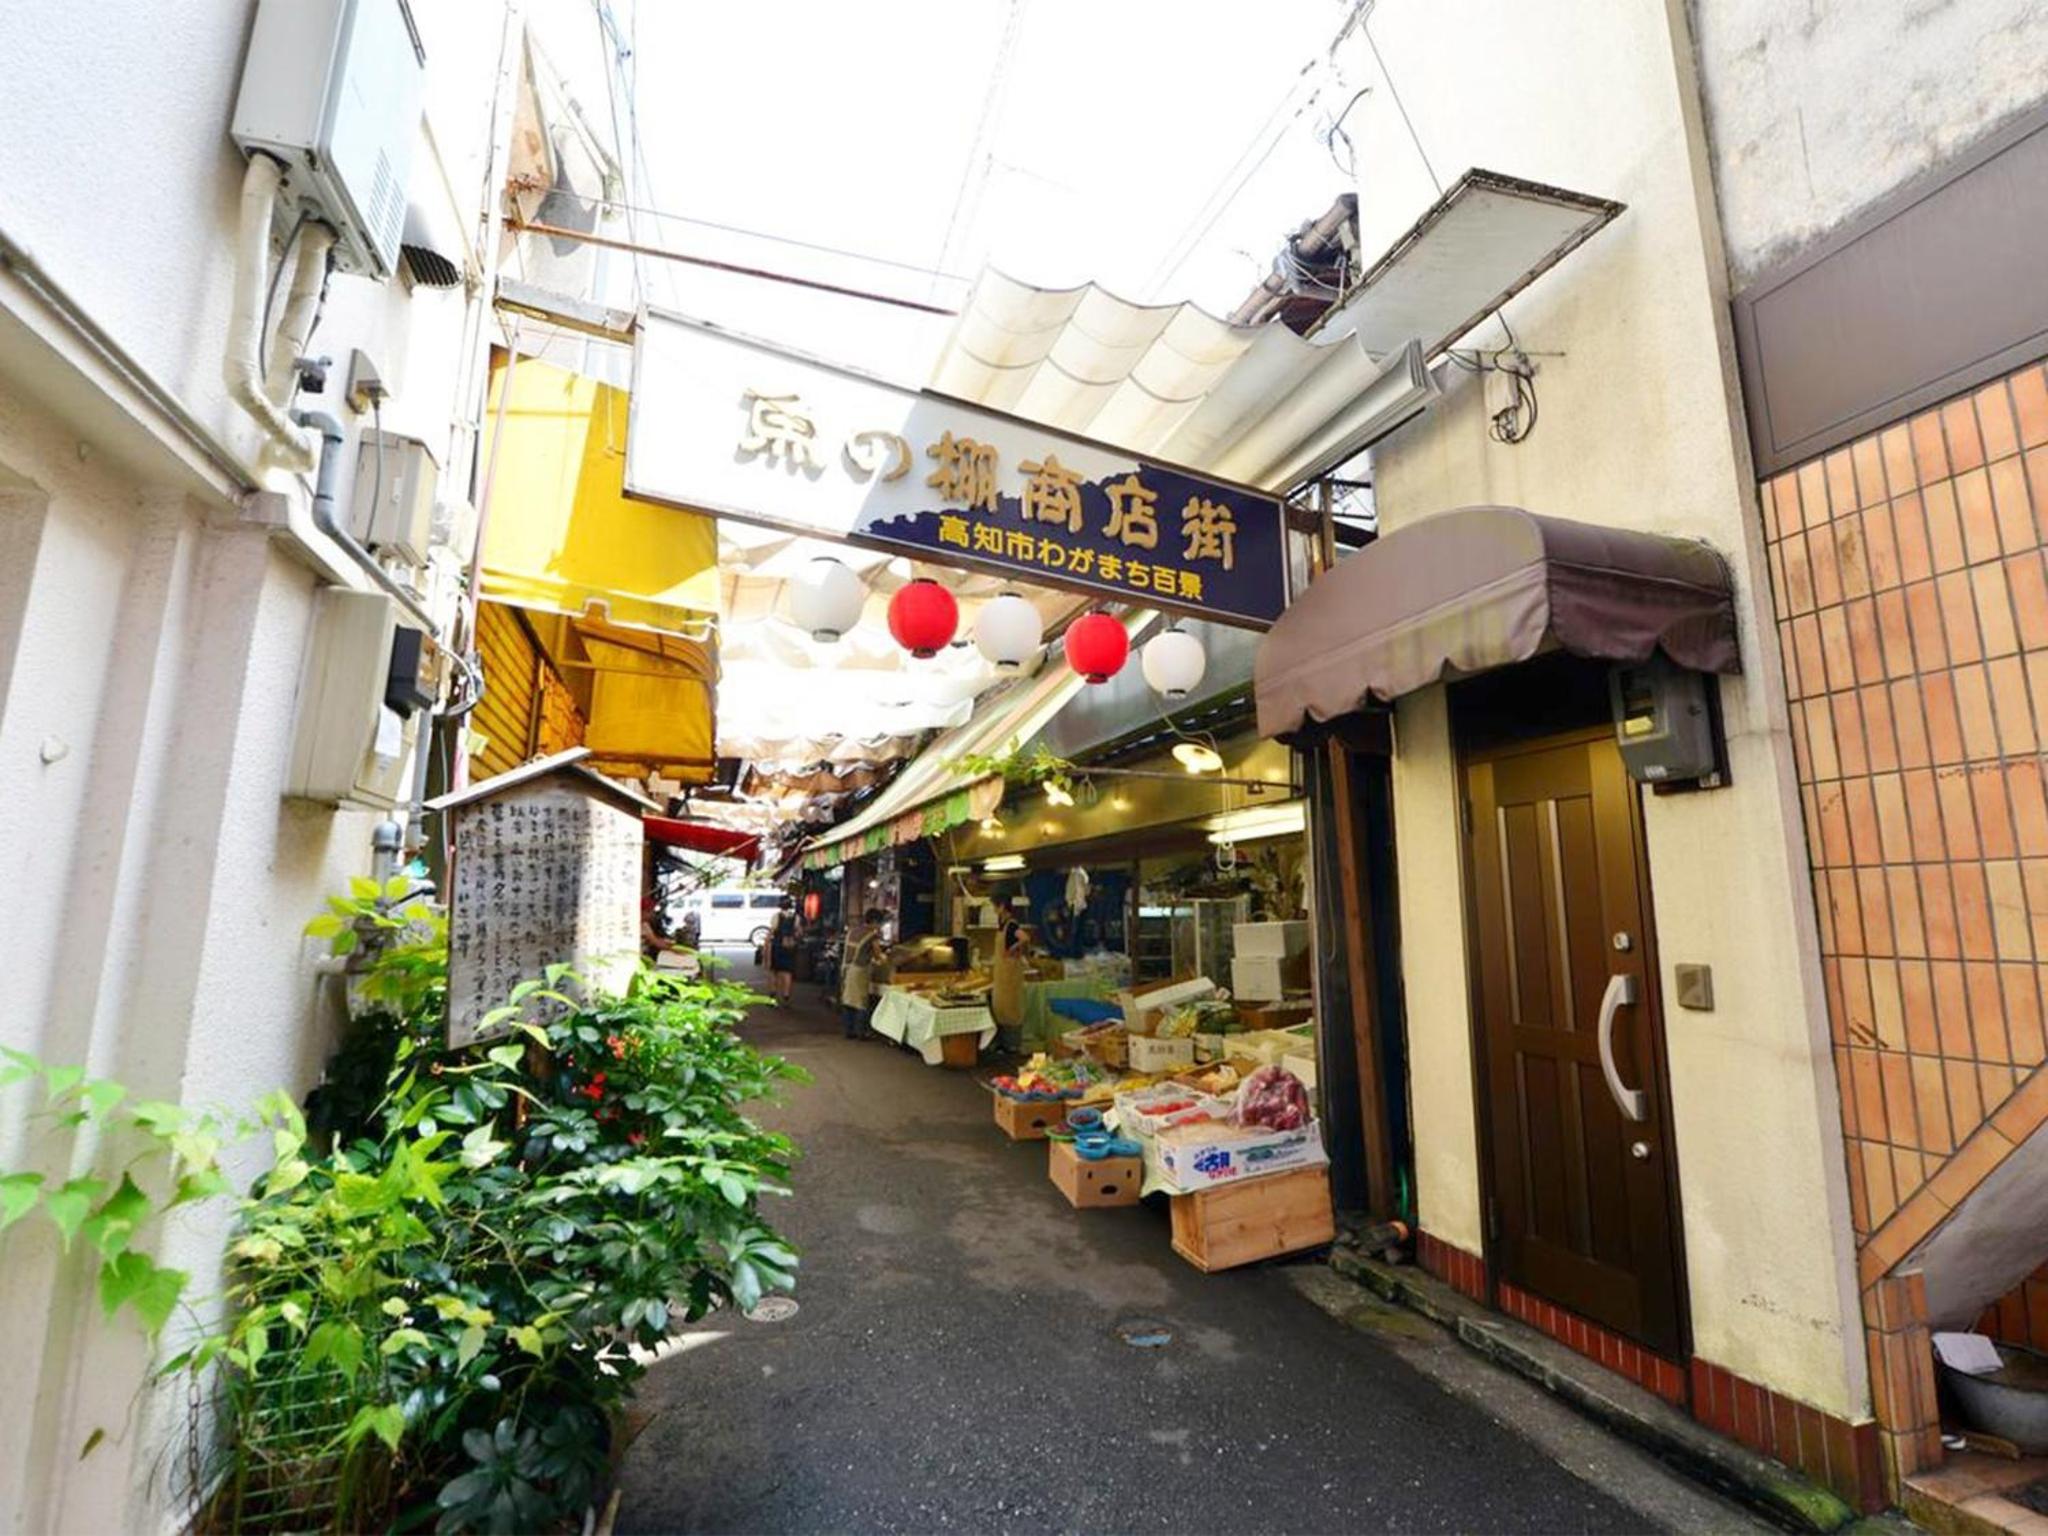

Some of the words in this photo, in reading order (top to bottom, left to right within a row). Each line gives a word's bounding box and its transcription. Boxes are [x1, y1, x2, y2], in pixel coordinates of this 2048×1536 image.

[738, 388, 1237, 571] 魚の棚商店街
[938, 514, 1204, 602] 高知市わがまち百景
